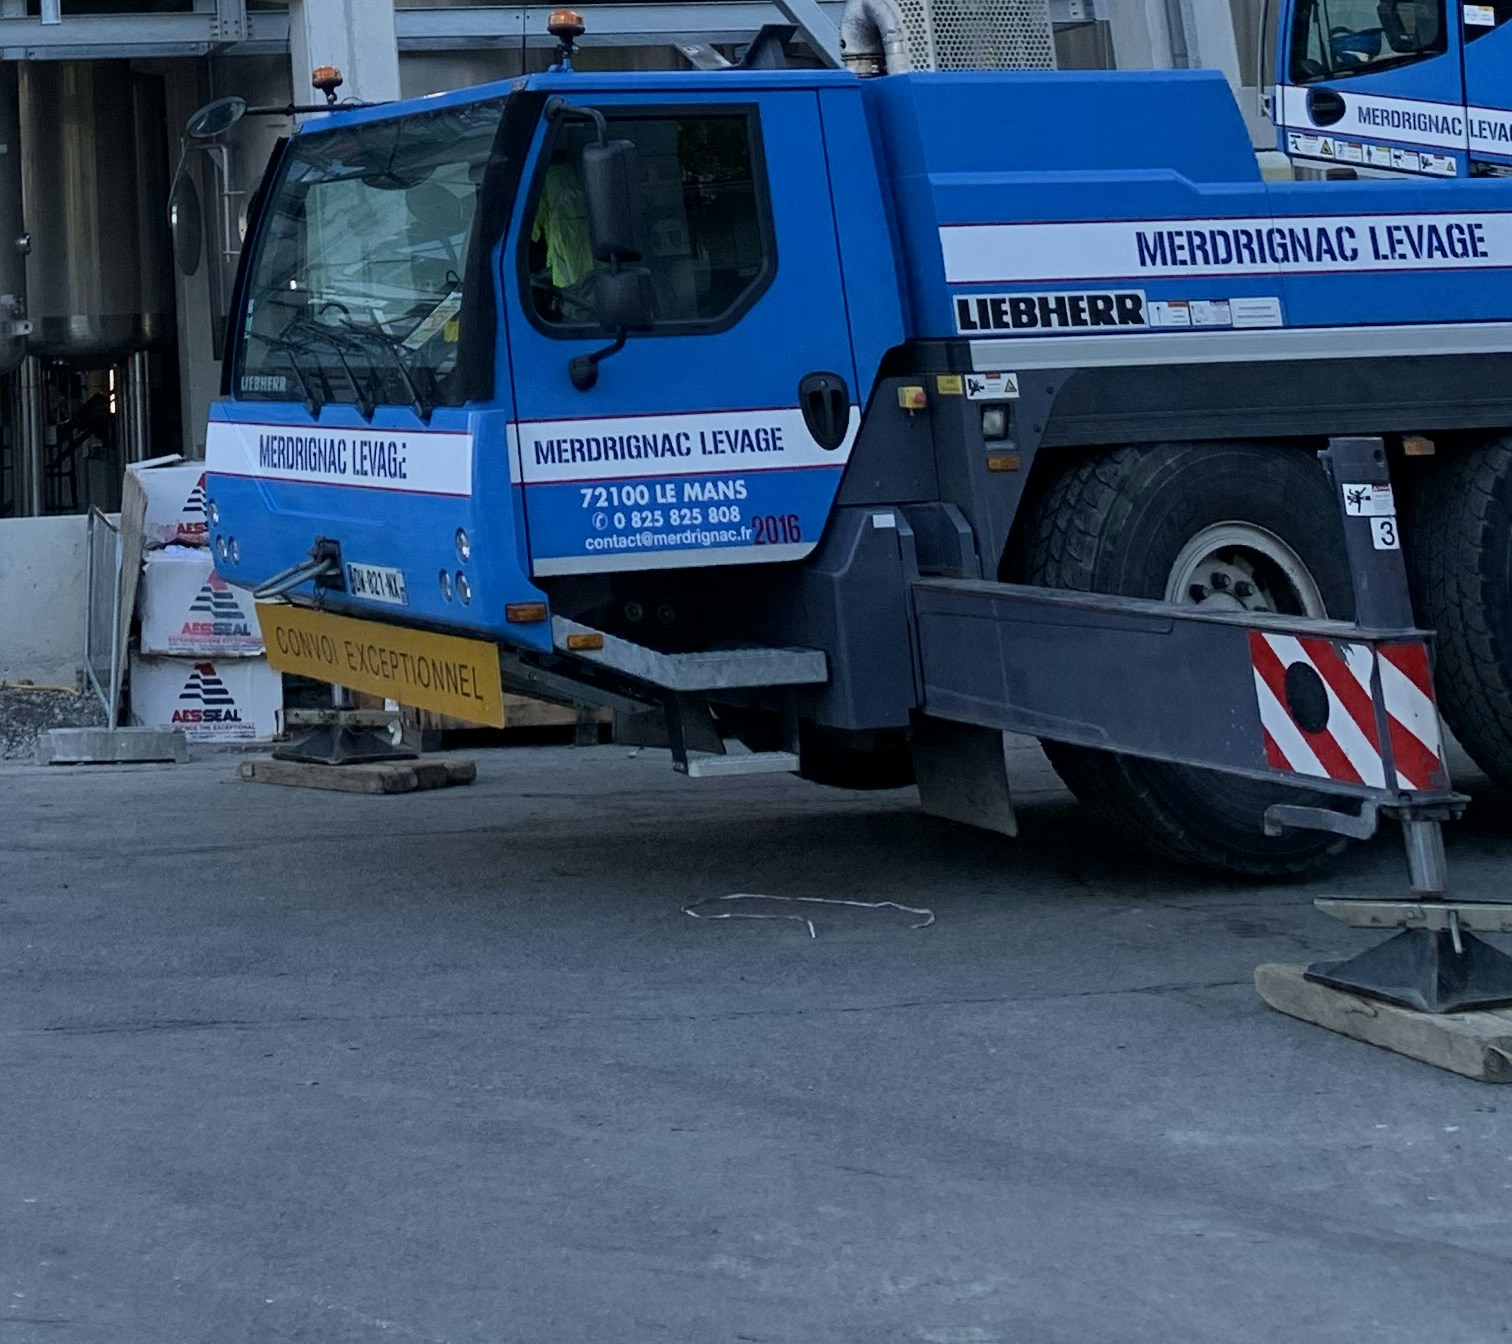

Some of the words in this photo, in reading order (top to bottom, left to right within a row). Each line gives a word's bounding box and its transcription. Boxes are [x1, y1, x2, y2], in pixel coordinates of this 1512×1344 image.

[1357, 105, 1463, 137] MERDRIGNAC
[1469, 118, 1512, 143] LEVA
[1135, 226, 1359, 267] MERDRIGNAC
[1369, 222, 1489, 261] LEVAGE
[956, 293, 1146, 331] LIEBHERR
[240, 375, 287, 392] LIEBHERR
[259, 434, 347, 475] MERDRIGNAC
[534, 432, 692, 465] MERDRIGNAC
[699, 427, 785, 456] LEVAGE
[580, 485, 649, 509] 72100
[655, 483, 677, 504] LE
[683, 479, 747, 503] MANS
[614, 512, 626, 529] 0
[631, 511, 663, 528] 825
[669, 508, 702, 526] 825
[708, 505, 740, 523] 808
[751, 513, 802, 545] 2016
[585, 527, 753, 551] contact@merdrignac.fr
[1380, 521, 1396, 546] 3
[181, 622, 252, 636] AESSEAL
[275, 626, 338, 664] CONVOI
[343, 640, 484, 701] EXCEPTIONNEL
[171, 708, 242, 723] AESSEAL
